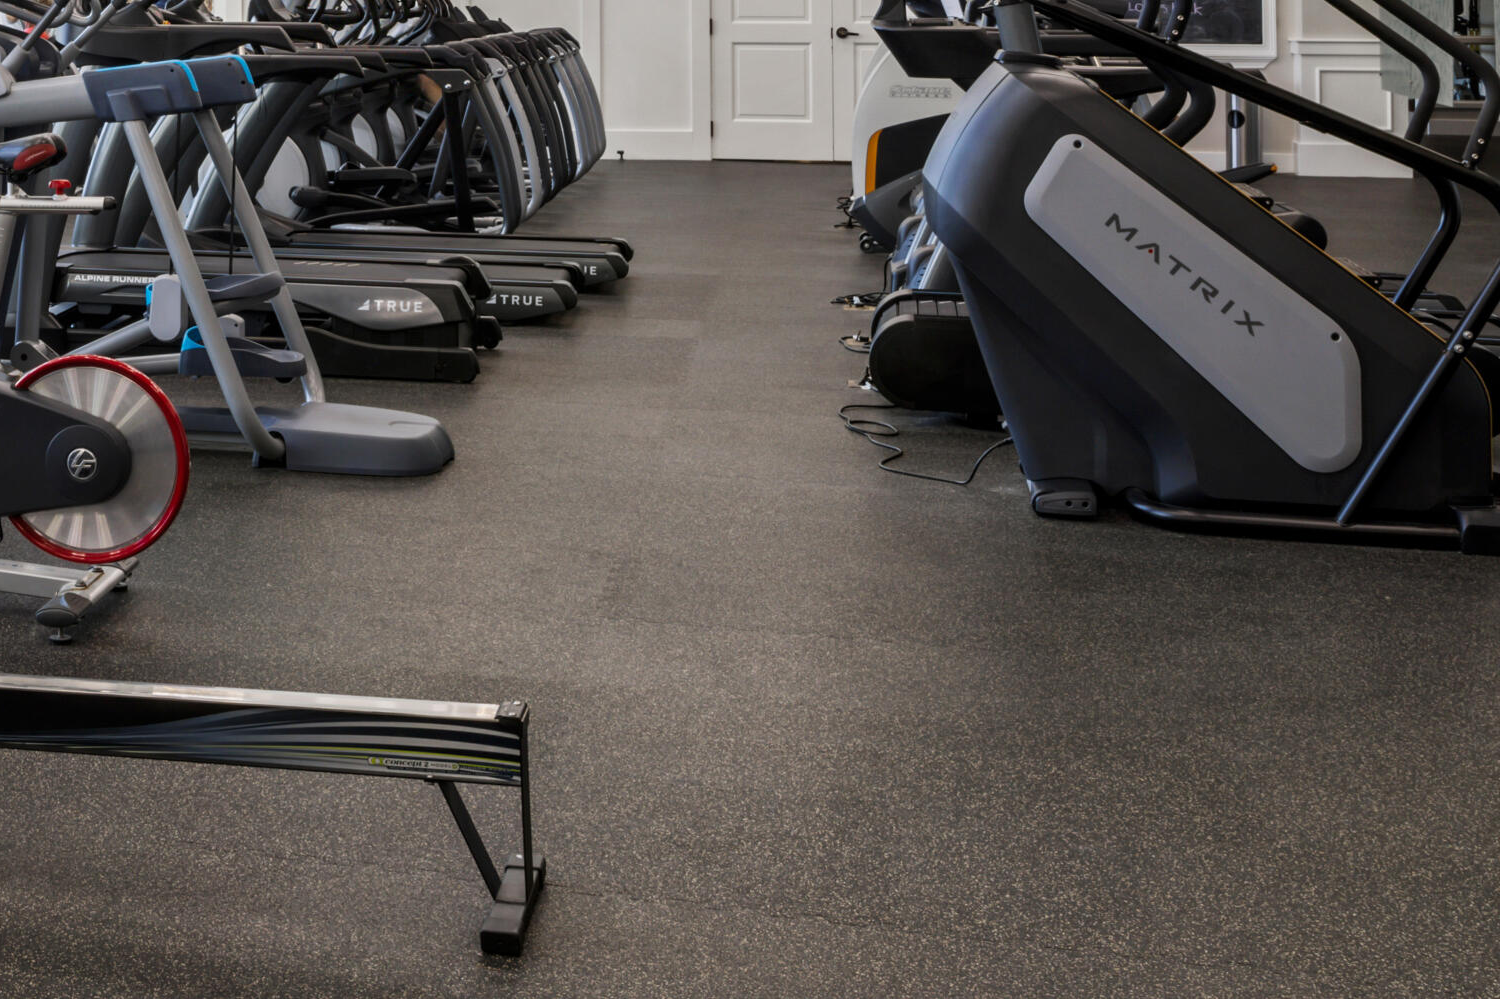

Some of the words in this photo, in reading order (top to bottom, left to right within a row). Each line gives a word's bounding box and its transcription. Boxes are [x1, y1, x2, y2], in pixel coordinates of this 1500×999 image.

[74, 273, 110, 284] ALPINE
[1104, 212, 1266, 337] MATRIX
[373, 298, 423, 313] TRUE
[500, 294, 544, 306] TRUE
[384, 759, 422, 768] concept
